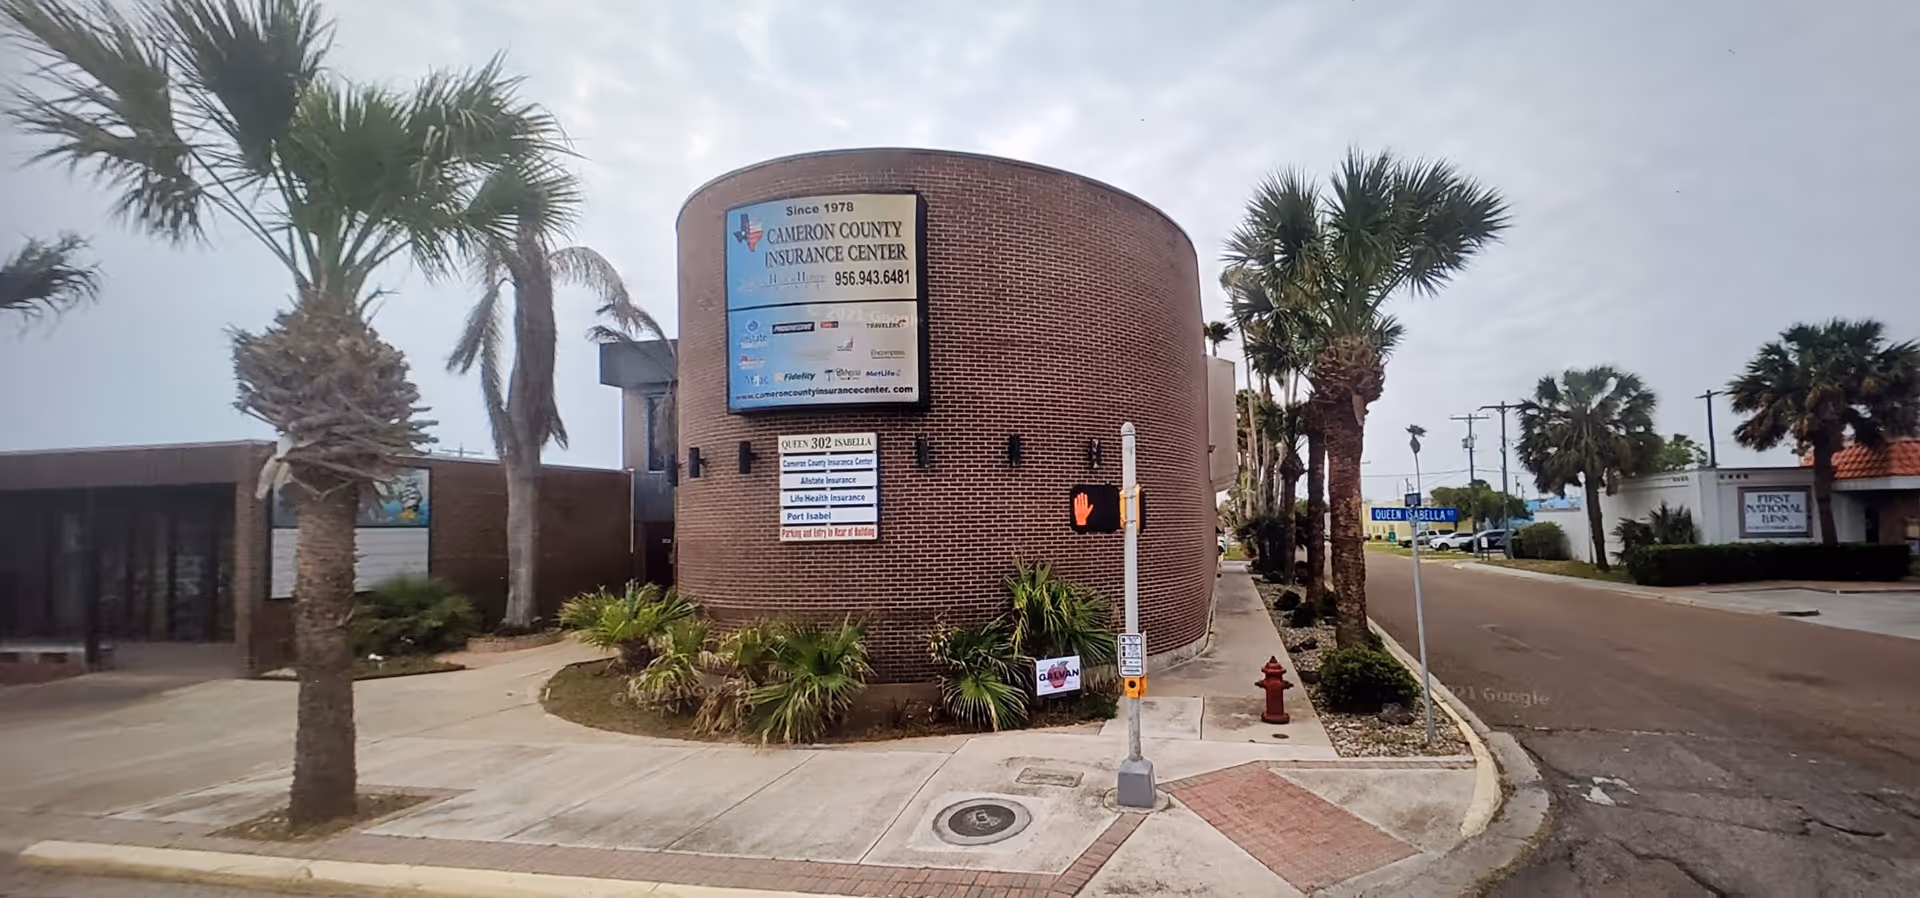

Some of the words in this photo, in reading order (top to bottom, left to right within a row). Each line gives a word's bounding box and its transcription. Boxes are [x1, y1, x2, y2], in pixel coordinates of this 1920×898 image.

[786, 205, 819, 216] Since
[824, 202, 854, 213] 1978
[767, 223, 835, 245] CAMERON
[839, 221, 902, 239] COUNTY
[765, 245, 844, 268] INSURANCE
[847, 243, 909, 261] CENTER
[834, 269, 910, 286] 956.943.6481
[784, 371, 816, 383] Fidelity
[781, 439, 809, 449] QUEEN
[811, 436, 832, 449] 302
[834, 437, 872, 447] ISABELLA
[807, 459, 826, 468] County
[827, 458, 853, 466] Insurance
[855, 457, 873, 465] Center
[800, 477, 824, 485] Allstate
[826, 476, 856, 484] Insurance
[830, 494, 865, 502] Insurance
[1757, 494, 1790, 503] FIRST
[787, 512, 804, 520] Port
[806, 511, 832, 520] Isabel
[1375, 509, 1401, 520] QUEEN
[1405, 509, 1446, 520] ISABELLA
[1038, 668, 1079, 681] GALVAN
